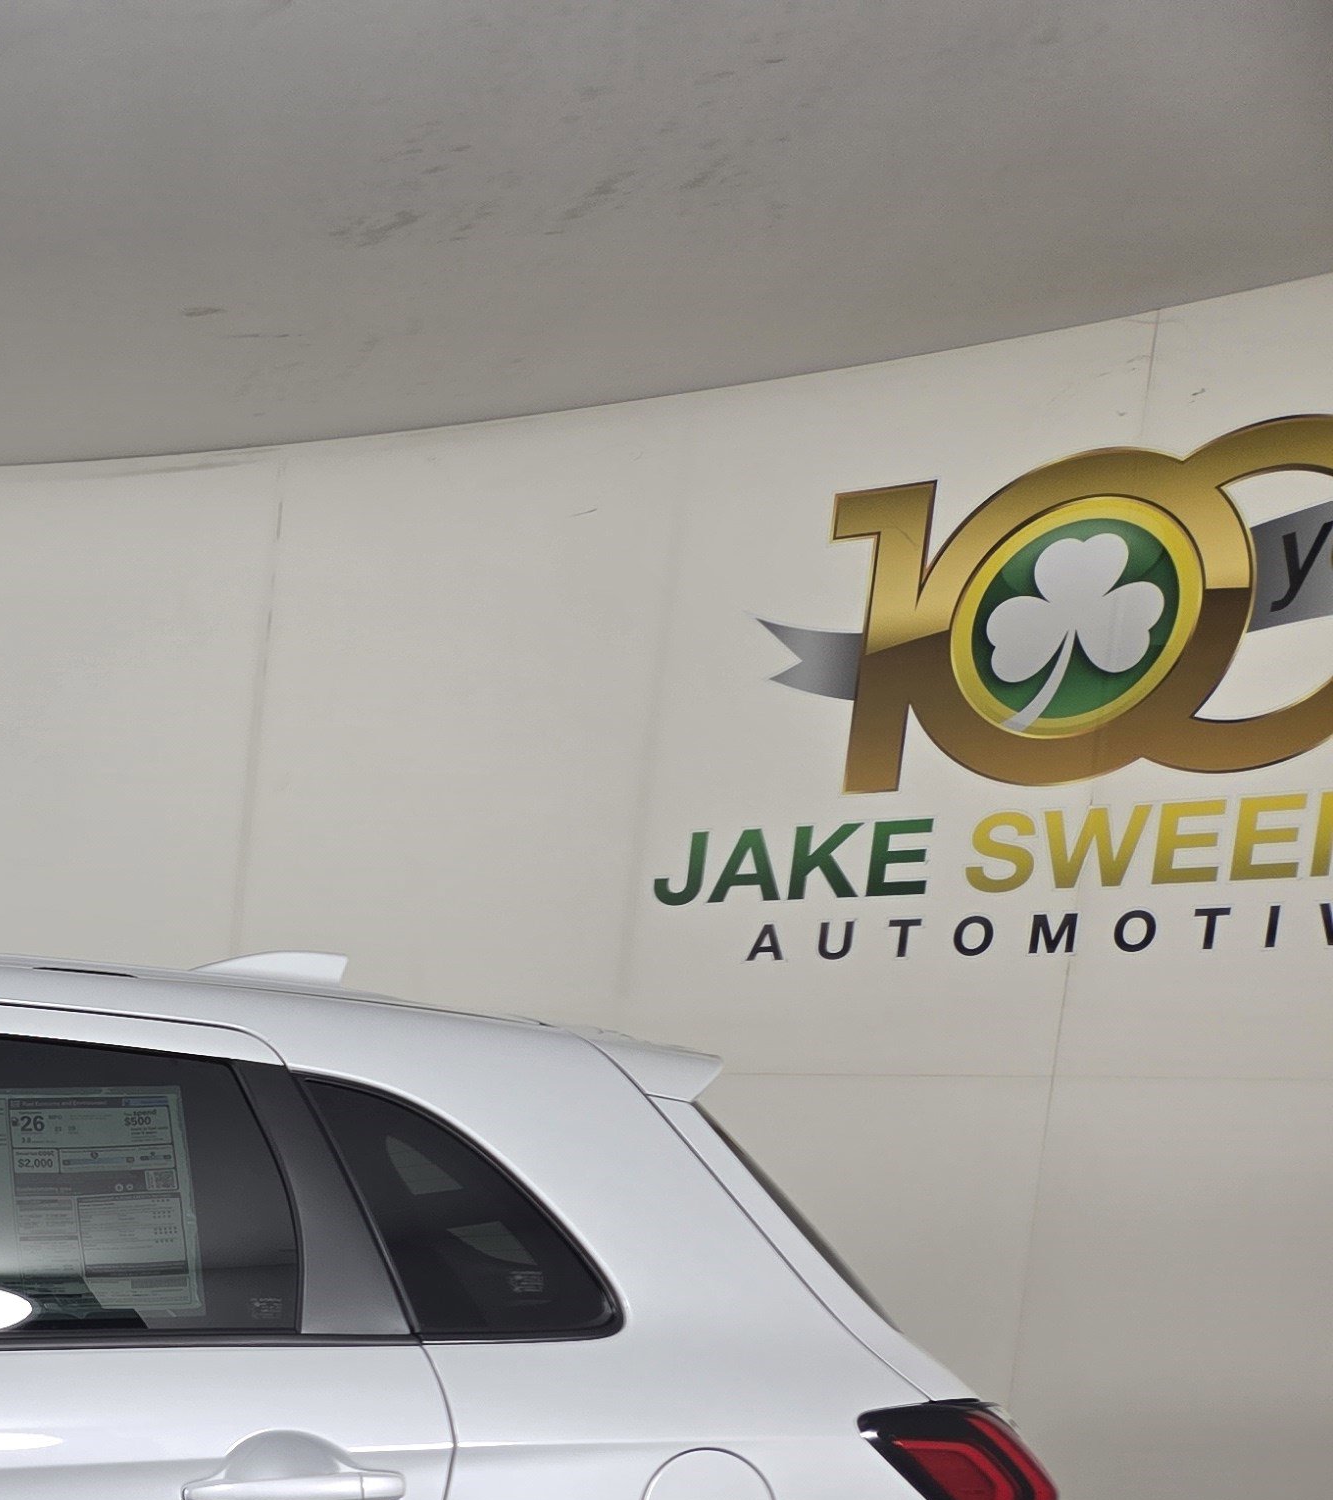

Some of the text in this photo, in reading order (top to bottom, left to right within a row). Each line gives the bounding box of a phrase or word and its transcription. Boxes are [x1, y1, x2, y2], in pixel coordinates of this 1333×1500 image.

[653, 817, 935, 907] JAKE
[20, 1115, 45, 1132] 26
[124, 1116, 152, 1127] $500
[17, 1158, 54, 1169] $2,000
